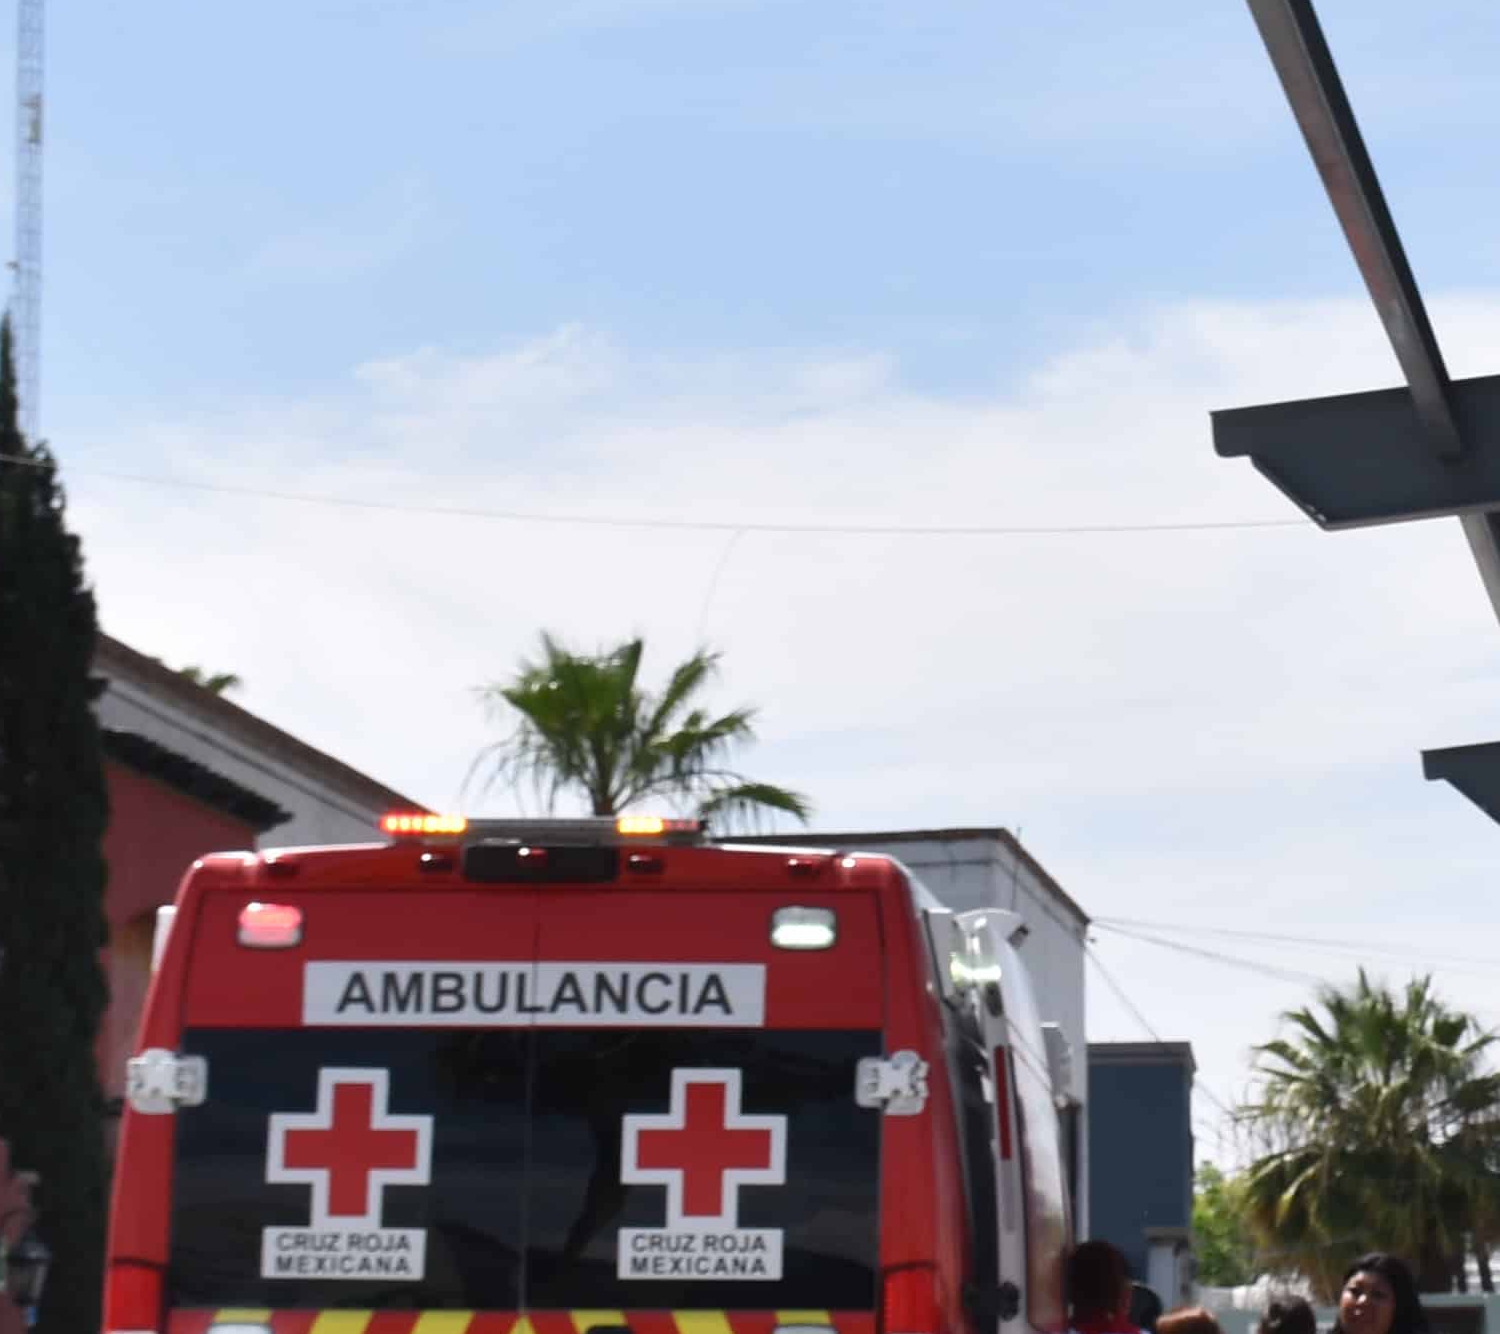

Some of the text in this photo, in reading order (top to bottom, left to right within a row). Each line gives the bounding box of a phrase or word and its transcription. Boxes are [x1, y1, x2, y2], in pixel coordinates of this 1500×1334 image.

[335, 971, 733, 1014] AMBULANCIA
[276, 1232, 411, 1253] CRUZ ROJA
[631, 1234, 766, 1254] CRUZ ROJA
[275, 1255, 411, 1274] MEXICANA
[630, 1256, 766, 1275] MEXICANA
